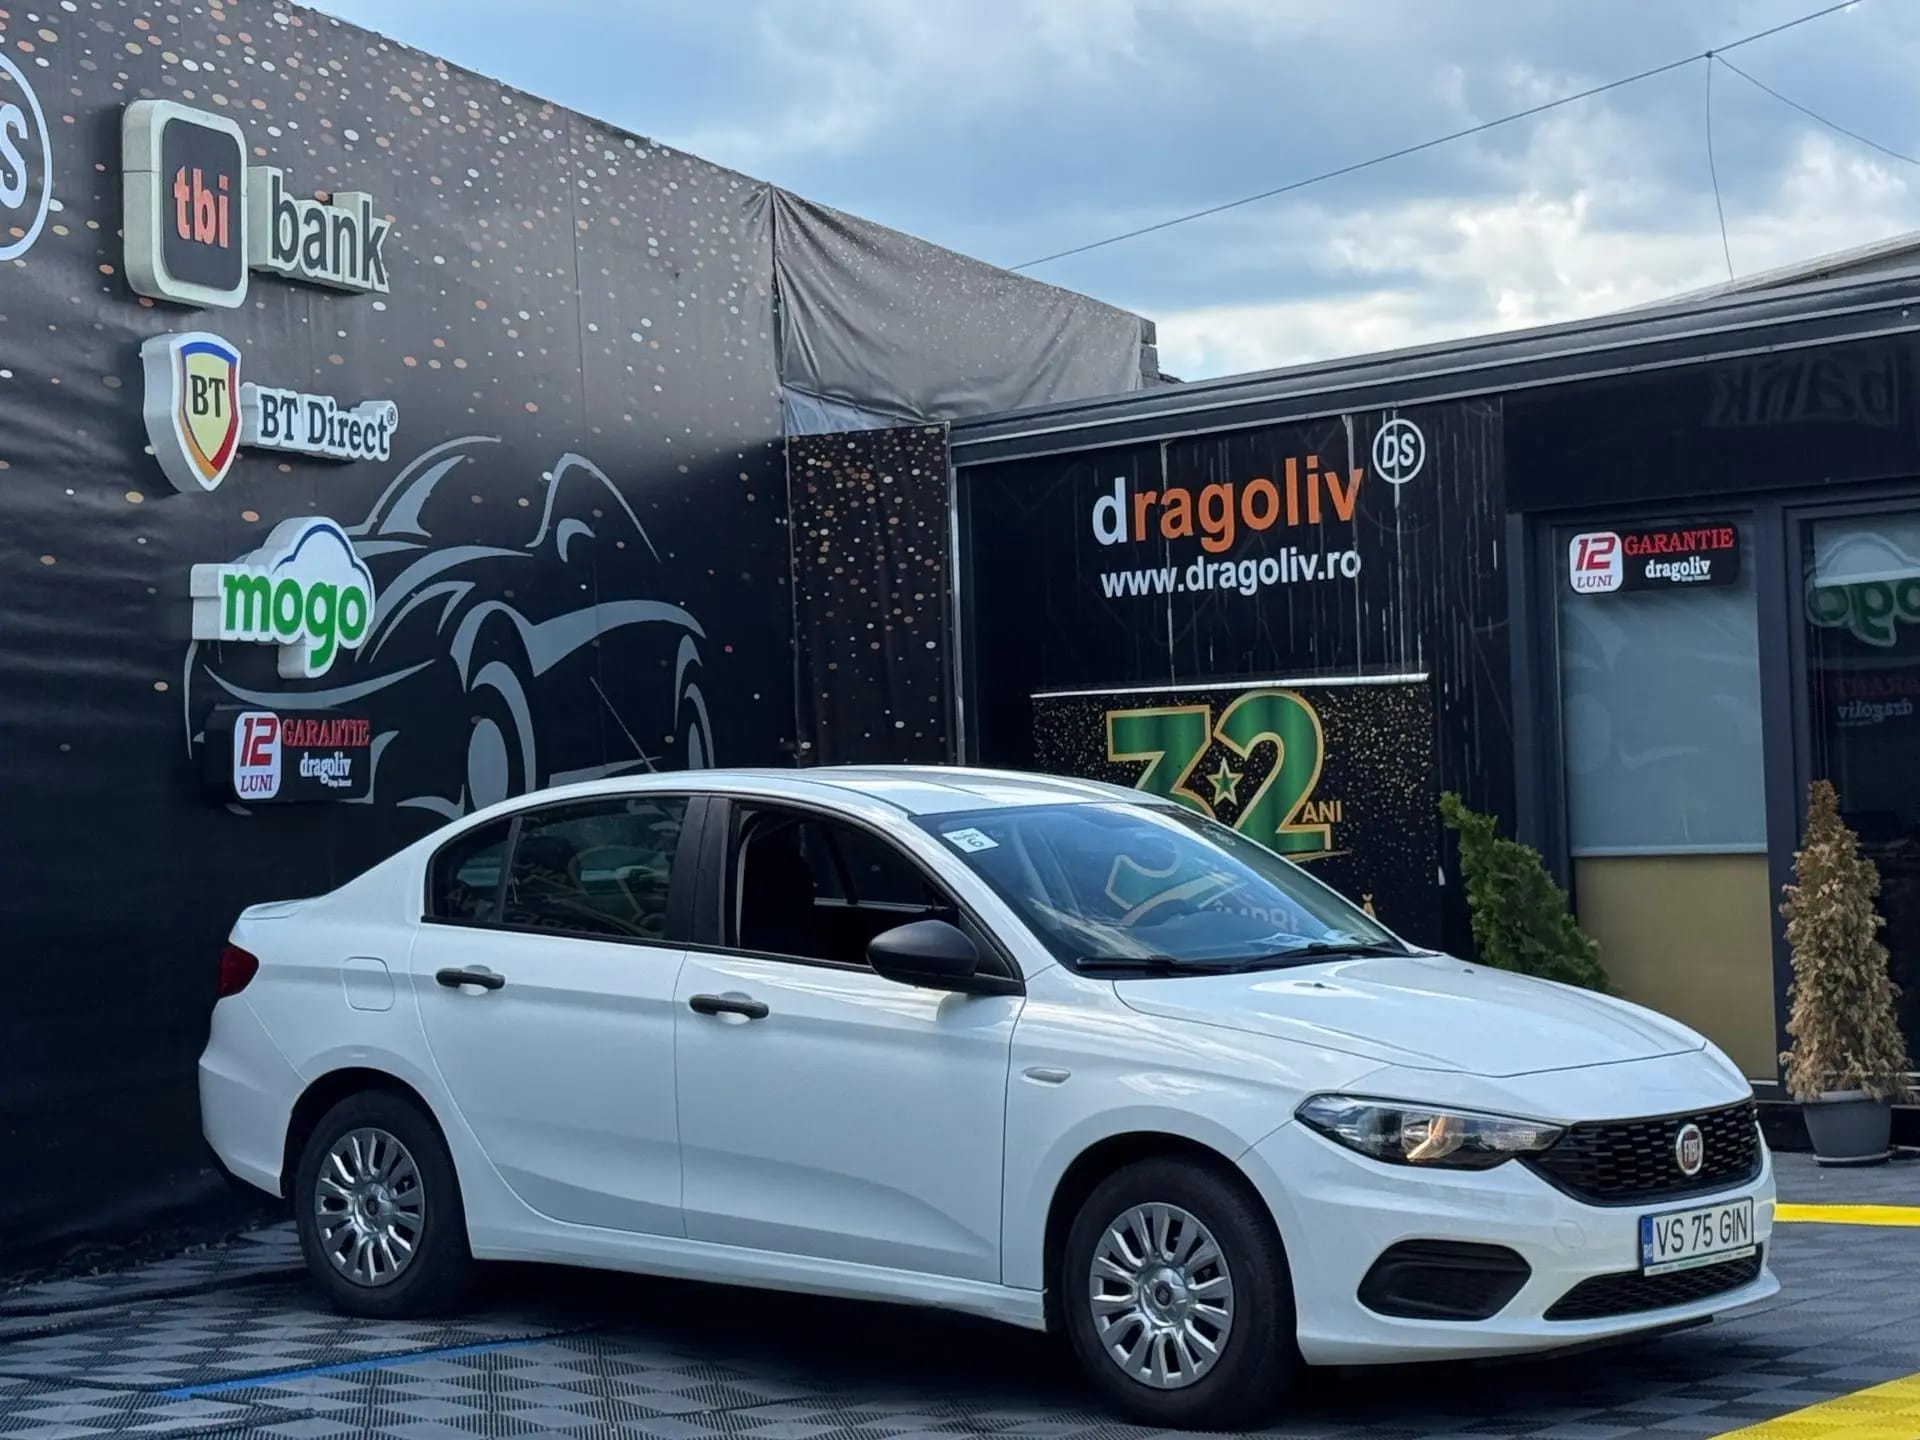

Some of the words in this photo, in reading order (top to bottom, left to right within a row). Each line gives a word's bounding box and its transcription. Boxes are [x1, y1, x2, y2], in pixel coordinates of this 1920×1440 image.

[173, 165, 229, 249] tbi
[271, 175, 388, 285] bank
[190, 374, 226, 418] BT
[260, 394, 299, 441] BT
[1381, 428, 1416, 469] DS
[1092, 455, 1364, 553] dragoliv
[1575, 536, 1616, 572] 12
[1623, 527, 1734, 556] GARANTIE
[1645, 556, 1711, 582] dragoliv
[1100, 547, 1362, 598] www.dragoliv.ro
[1577, 575, 1612, 589] LUNI
[223, 573, 367, 670] mogo
[240, 717, 278, 768] 12
[282, 718, 370, 748] GARANTIE
[240, 774, 273, 793] LUNI
[299, 751, 352, 784] dragoliv
[1301, 800, 1343, 825] ANI
[1656, 1217, 1684, 1257] VS
[1691, 1212, 1713, 1252] 75
[1719, 1206, 1748, 1245] GIN
